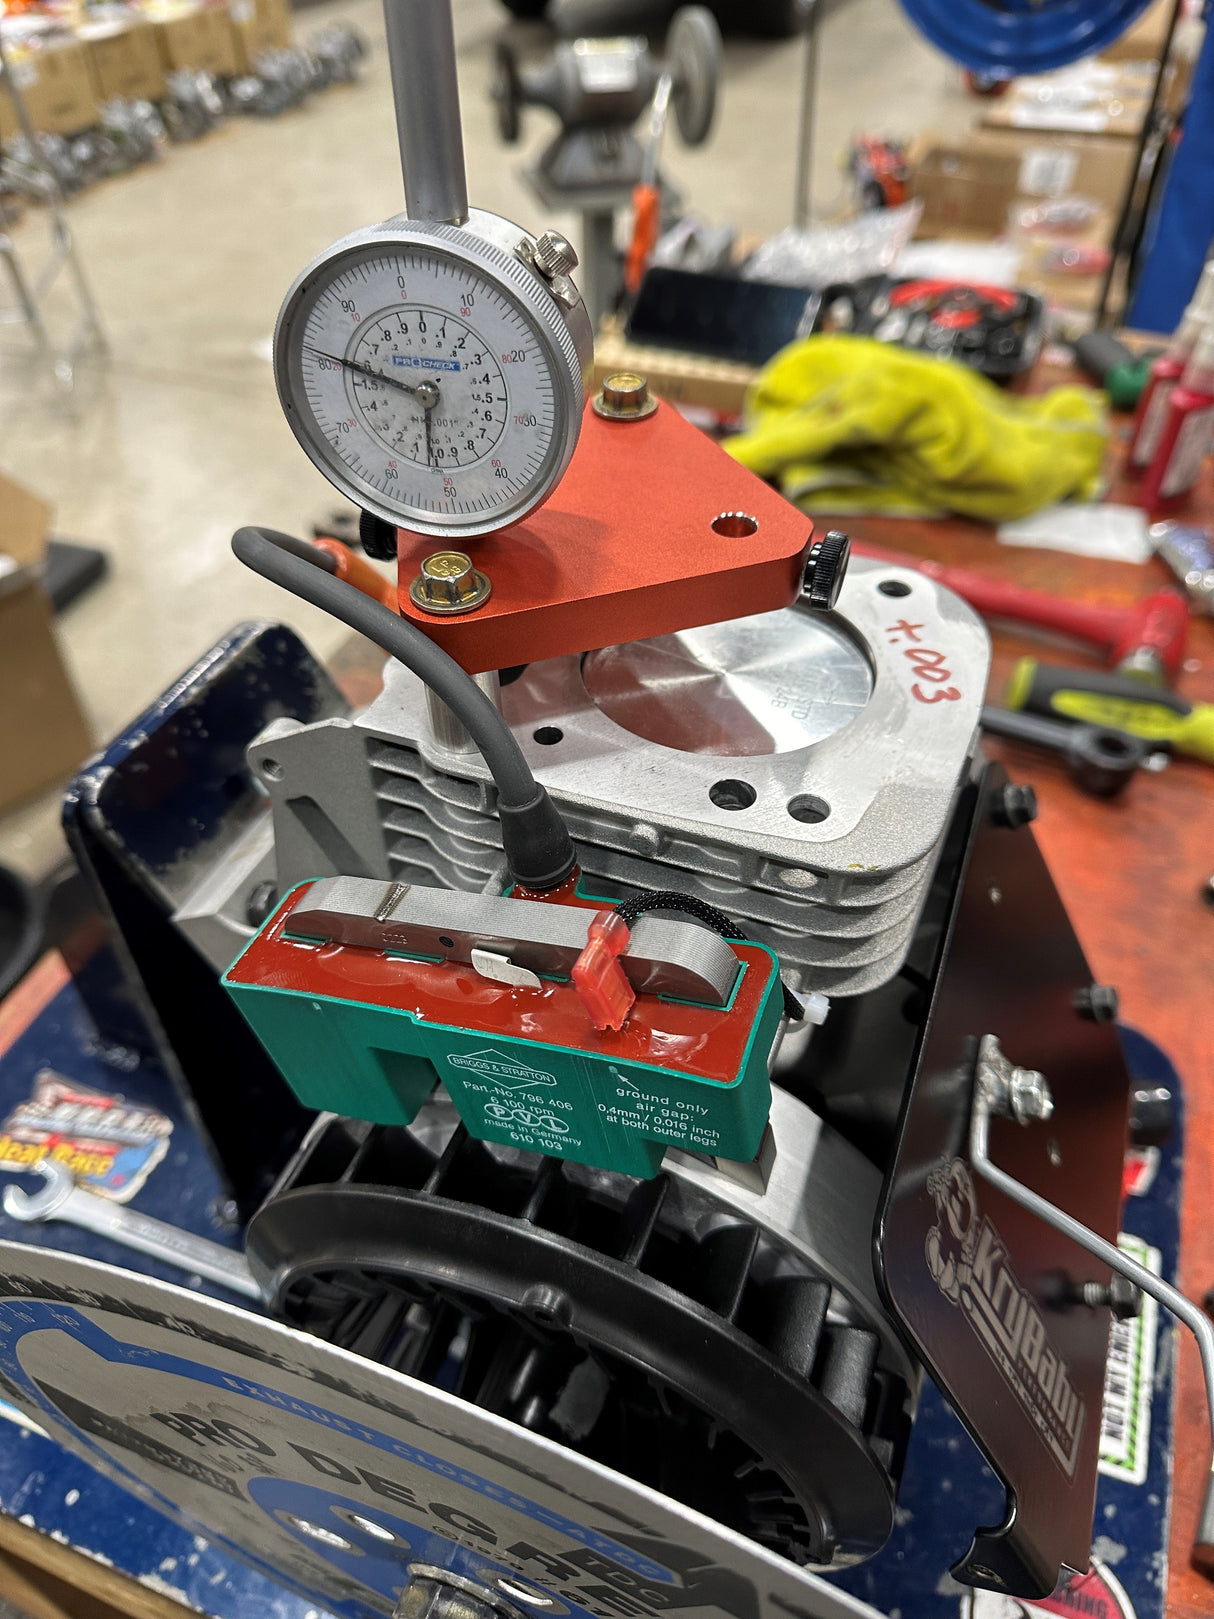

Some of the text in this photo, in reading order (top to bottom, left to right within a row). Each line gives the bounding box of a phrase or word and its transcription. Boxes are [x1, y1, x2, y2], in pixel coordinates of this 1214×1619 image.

[397, 276, 405, 289] 0
[401, 290, 407, 299] 0
[461, 294, 475, 307] 10
[341, 300, 356, 313] 90
[460, 307, 471, 317] 90
[351, 312, 361, 322] 10
[397, 322, 409, 335] .9
[419, 321, 427, 333] 0
[436, 327, 446, 339] .1
[380, 330, 392, 342] .8
[369, 344, 379, 355] .7
[454, 337, 466, 350] .2
[470, 354, 482, 365] .3
[502, 354, 512, 364] 80
[511, 349, 526, 362] 20
[318, 359, 332, 371] 80
[332, 362, 342, 371] 20
[479, 373, 491, 385] .4
[481, 392, 493, 404] .5
[366, 400, 378, 412] .4
[481, 410, 493, 422] .6
[514, 416, 524, 425] 70
[523, 415, 537, 427] 30
[336, 422, 350, 433] 70
[348, 418, 357, 427] 30
[392, 431, 405, 443] .2
[476, 427, 487, 439] .7
[410, 442, 419, 453] .1
[464, 440, 475, 451] .8
[447, 447, 458, 458] .9
[388, 460, 398, 469] 40
[491, 459, 502, 468] 60
[385, 468, 398, 480] 60
[495, 468, 508, 479] 40
[443, 477, 453, 486] 50
[444, 487, 457, 498] 50
[885, 619, 962, 704] +.003
[452, 1057, 551, 1082] BRIGGS & STRATTON
[490, 1096, 556, 1117] 6 100 rpm
[519, 1092, 545, 1105] 796
[548, 1099, 574, 1111] 406
[616, 1087, 709, 1116] ground only
[636, 1102, 694, 1122] air gap:
[484, 1118, 582, 1147] made in Germany
[606, 1115, 718, 1147] at both outer legs
[653, 1116, 688, 1131] 0.016
[692, 1125, 720, 1139] inch
[510, 1132, 563, 1151] 610 103
[222, 1376, 375, 1441] EXHAUST
[150, 1412, 277, 1457] PRO
[584, 1555, 670, 1602] TDC
